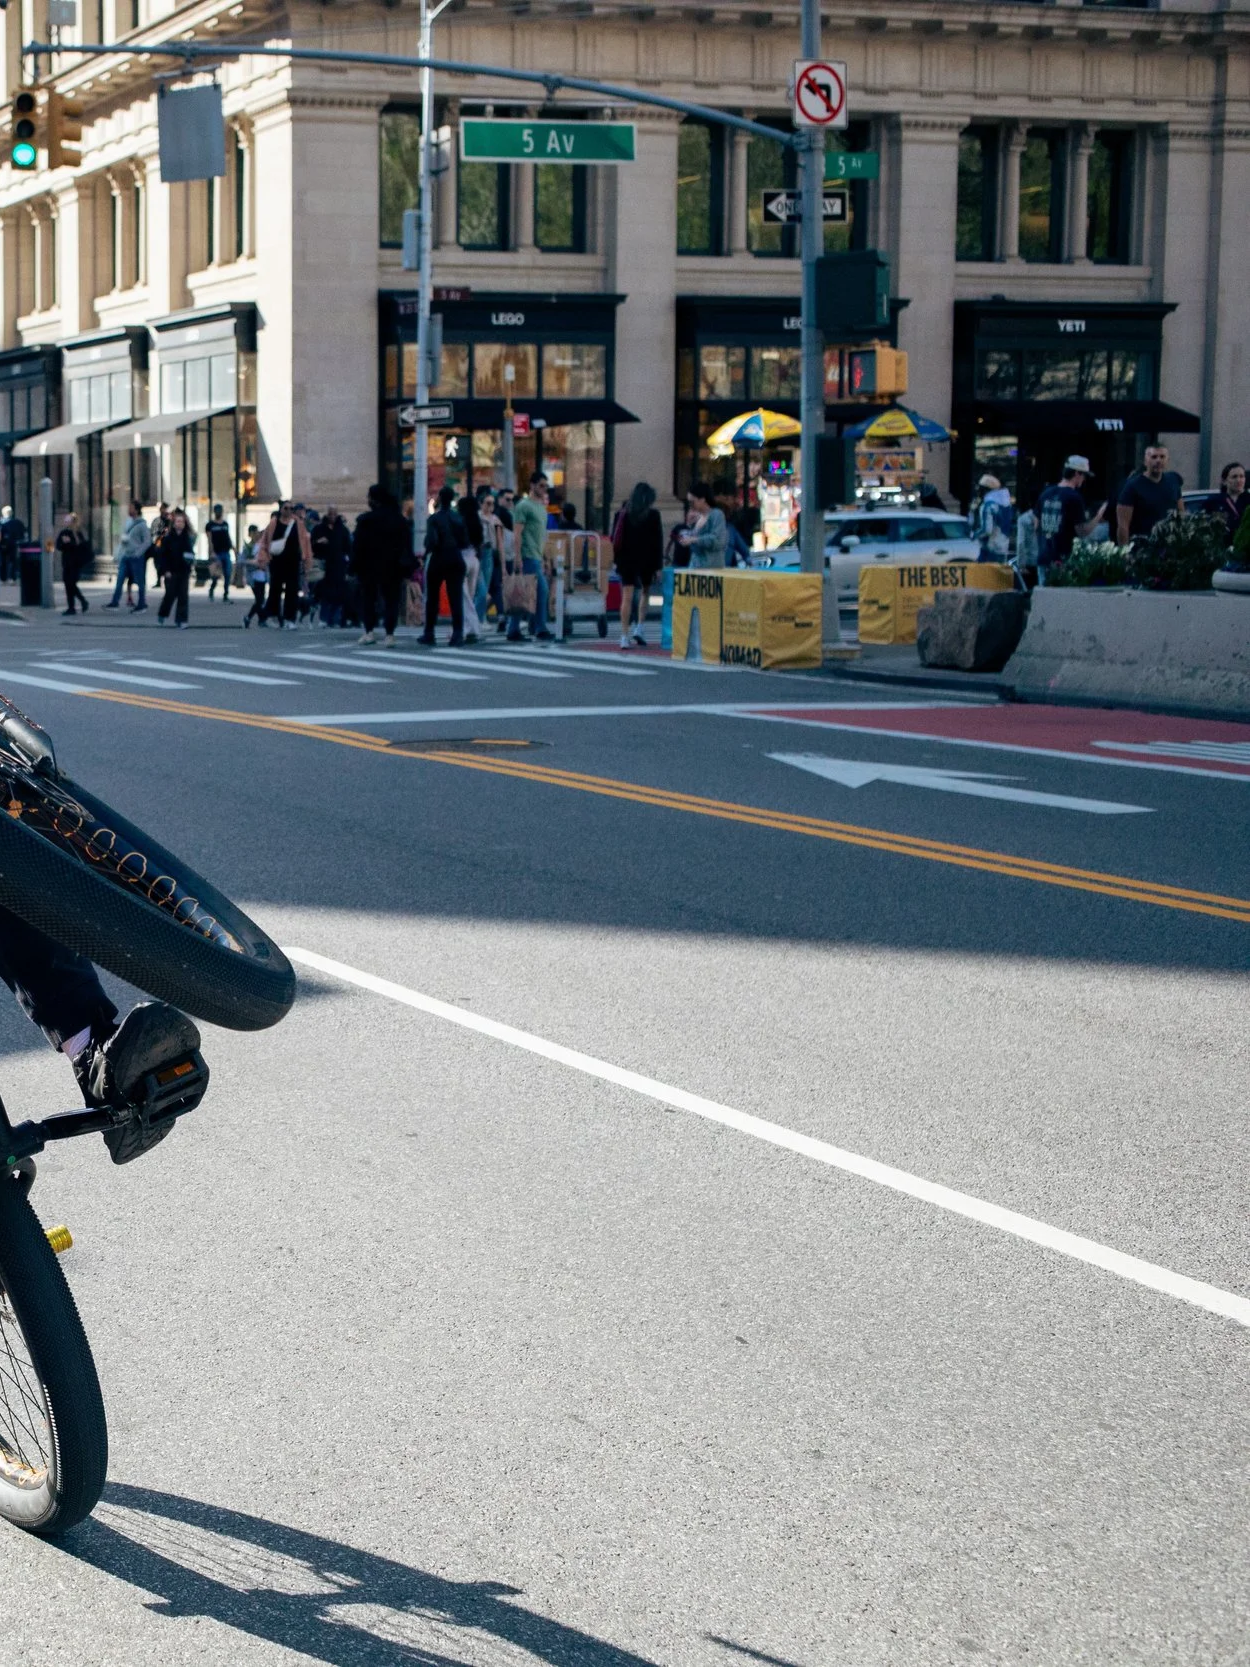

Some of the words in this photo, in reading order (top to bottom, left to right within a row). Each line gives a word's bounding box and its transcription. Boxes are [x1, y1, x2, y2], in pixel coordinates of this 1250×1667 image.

[522, 129, 535, 153] 5
[546, 130, 574, 153] Av
[838, 156, 846, 175] 5
[491, 312, 525, 325] LEGO
[1058, 319, 1085, 332] YETI
[1094, 418, 1123, 431] YETI
[674, 573, 724, 599] FLATIRON
[899, 566, 927, 587] THE
[931, 566, 967, 587] BEST
[719, 644, 762, 667] NOMAD
